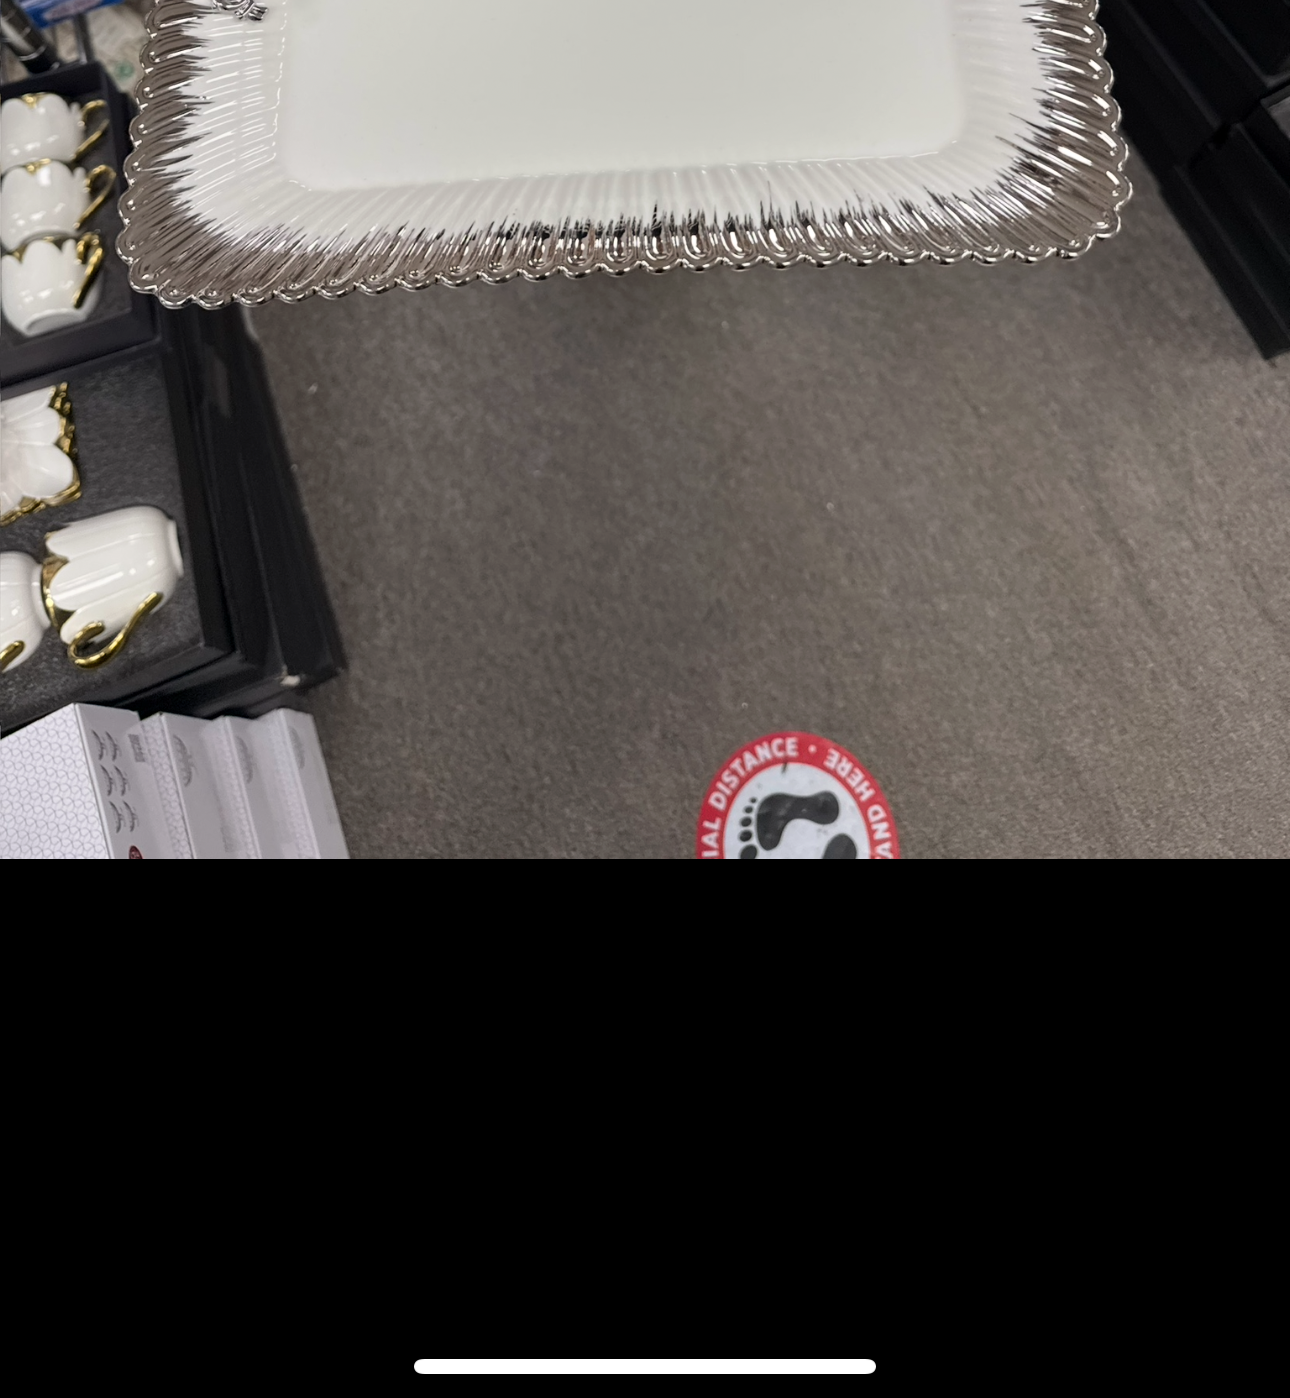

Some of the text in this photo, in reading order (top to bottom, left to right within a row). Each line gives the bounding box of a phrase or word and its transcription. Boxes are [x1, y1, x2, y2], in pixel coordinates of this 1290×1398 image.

[708, 736, 799, 812] DISTANCE
[823, 747, 894, 859] AND HERE
